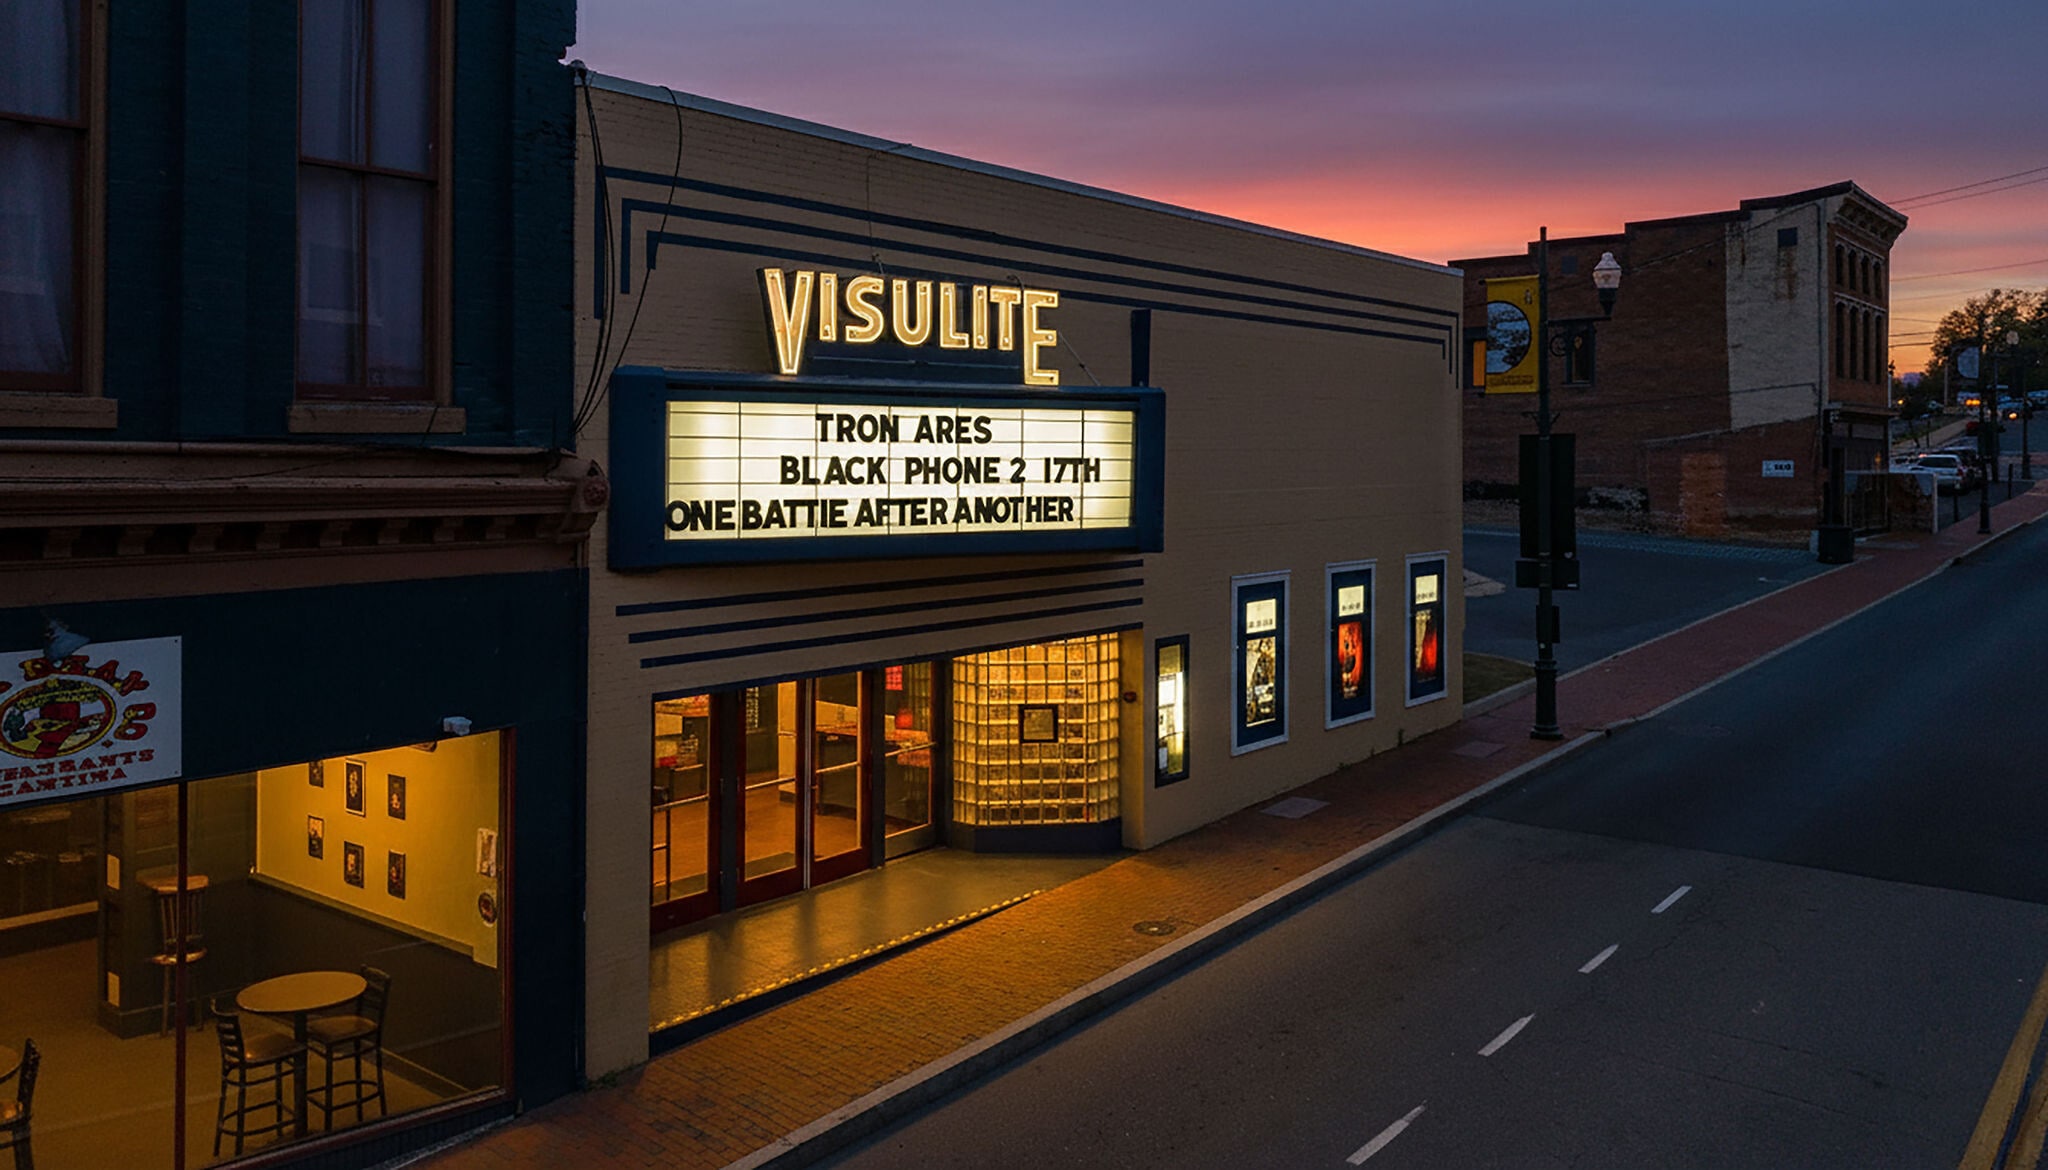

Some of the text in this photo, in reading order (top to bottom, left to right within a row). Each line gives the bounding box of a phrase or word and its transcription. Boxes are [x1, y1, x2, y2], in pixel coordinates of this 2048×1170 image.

[761, 268, 1059, 386] VISULITE
[816, 413, 993, 444] TRON ARES
[780, 455, 1101, 485] BLACK PHONE 2 17TH
[665, 499, 736, 532] ONE
[854, 498, 948, 528] AFTER
[952, 496, 1074, 524] ANOTHER
